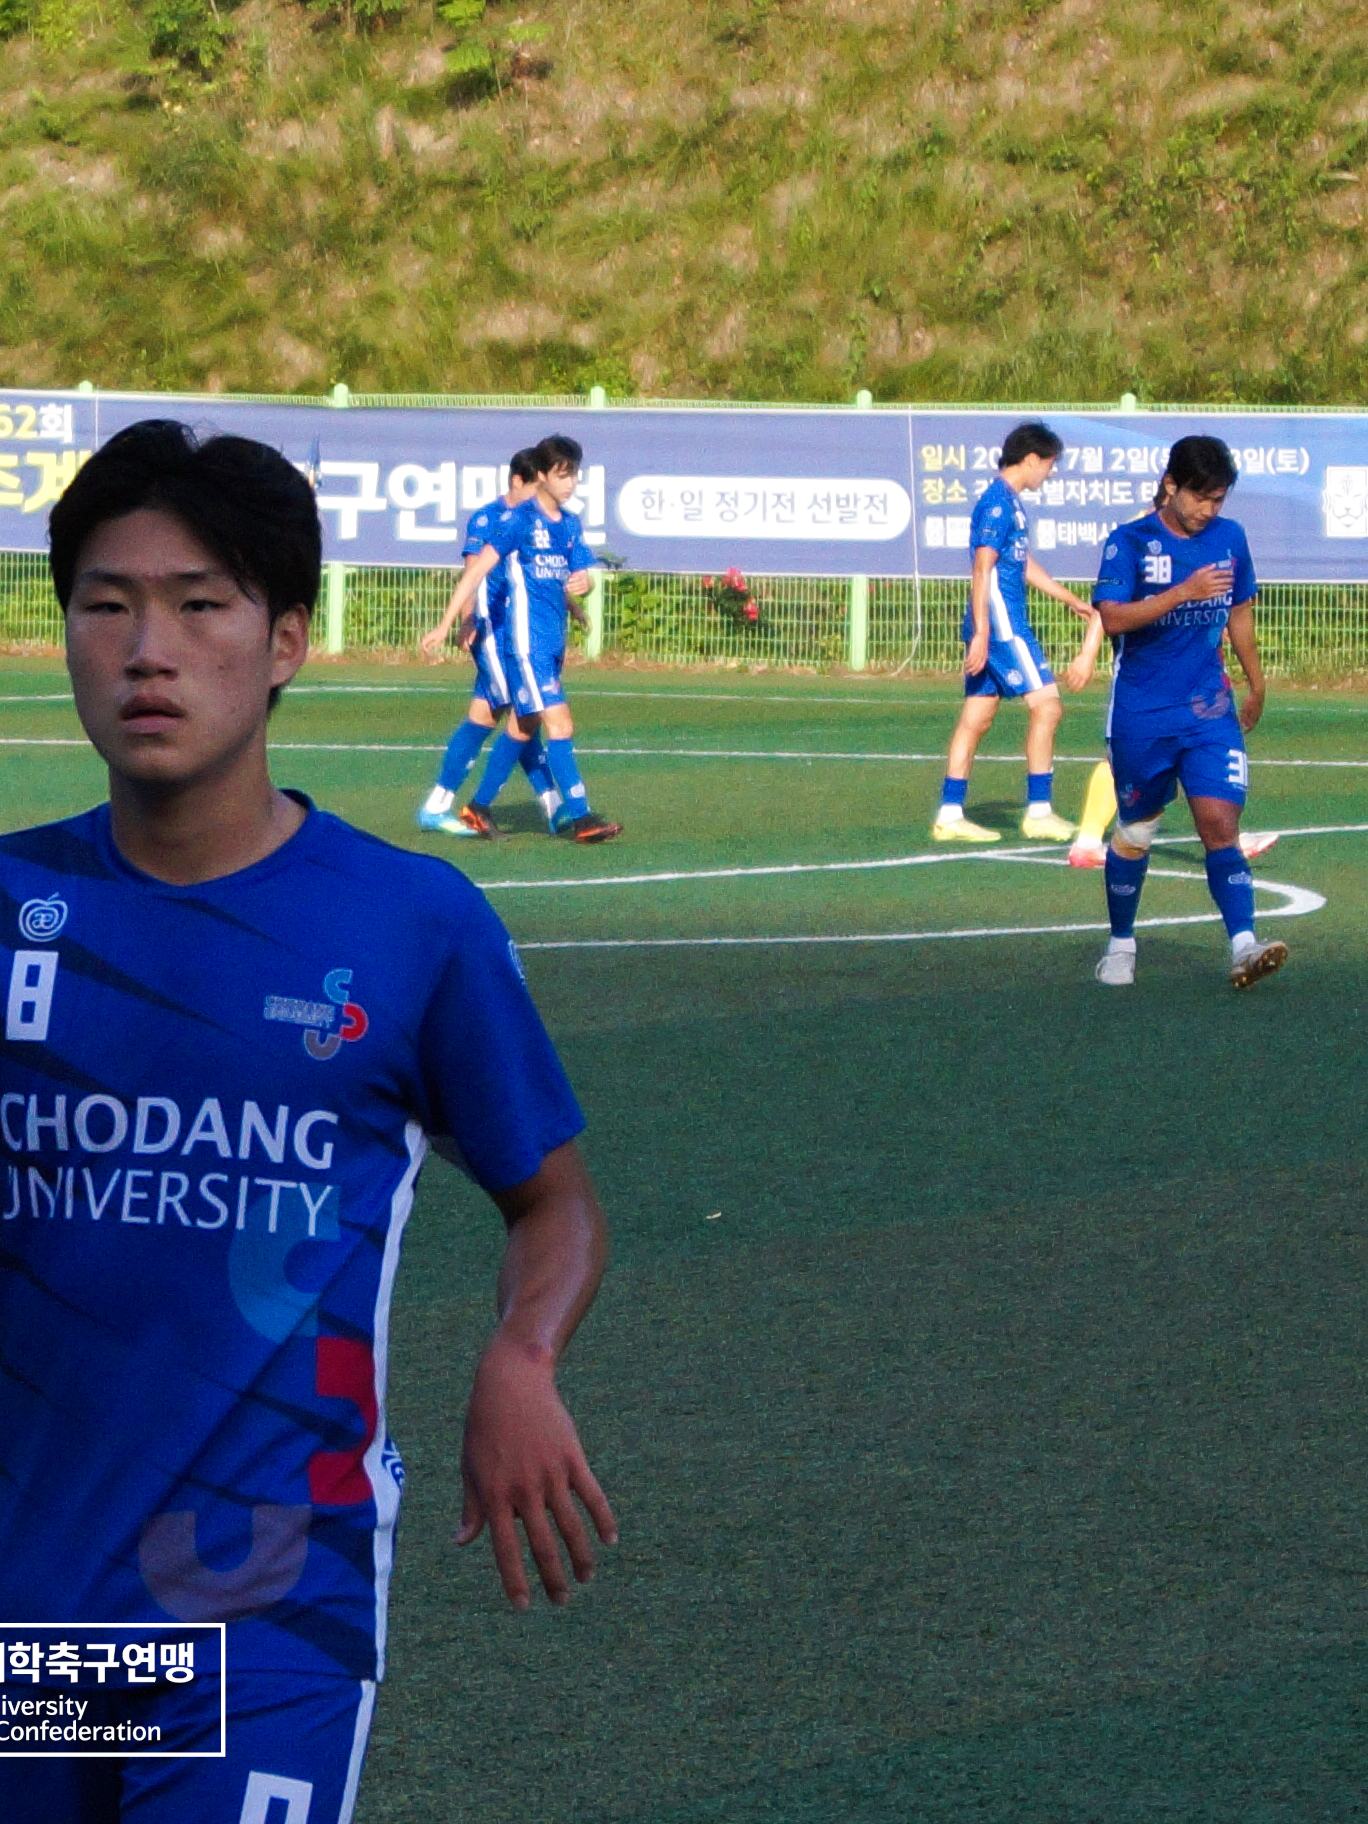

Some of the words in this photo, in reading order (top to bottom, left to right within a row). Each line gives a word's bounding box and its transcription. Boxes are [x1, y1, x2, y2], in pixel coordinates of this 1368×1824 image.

[921, 444, 967, 472] 일시
[1066, 446, 1104, 474] 7월
[1229, 445, 1310, 475] 3일(토)
[715, 489, 795, 523] 정기전
[806, 491, 888, 525] 선발전
[922, 476, 969, 504] 장소
[1143, 554, 1172, 584] 38
[1228, 748, 1249, 787] 3
[5, 949, 60, 1041] 8
[0, 1092, 340, 1170] CHODANG
